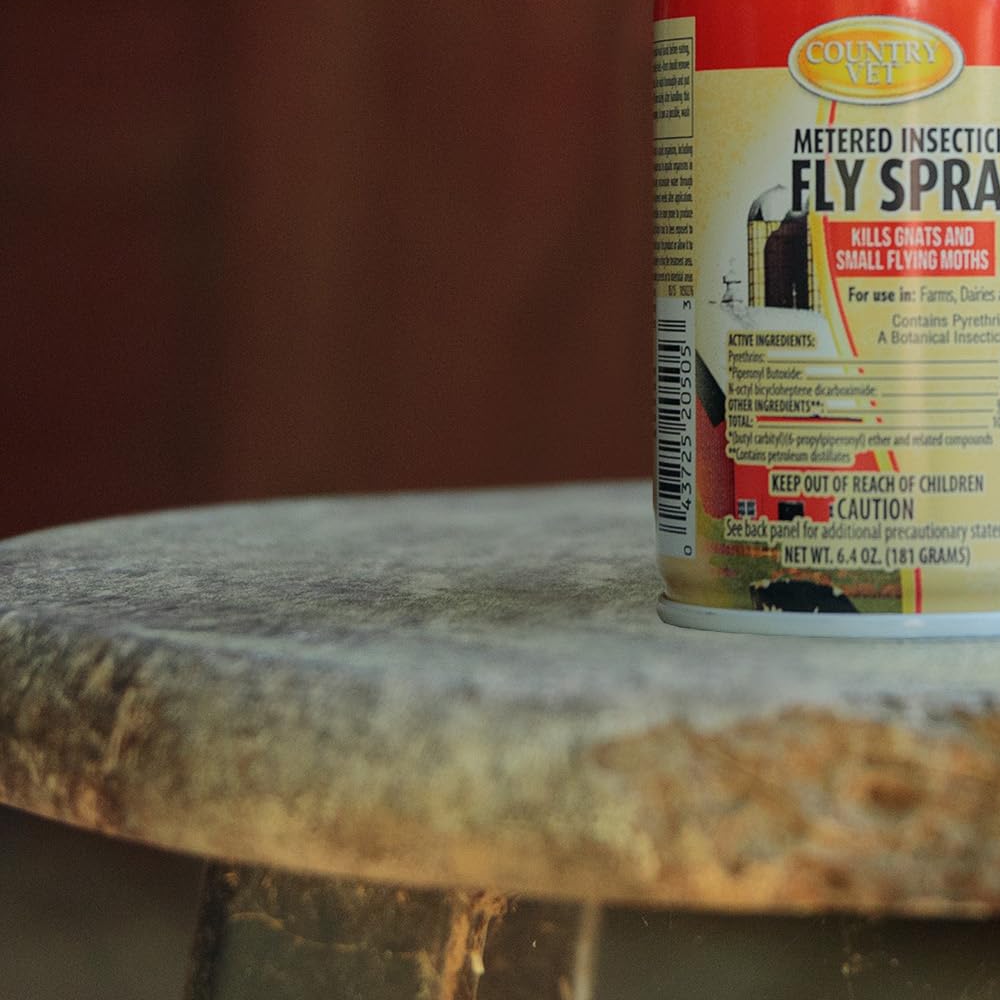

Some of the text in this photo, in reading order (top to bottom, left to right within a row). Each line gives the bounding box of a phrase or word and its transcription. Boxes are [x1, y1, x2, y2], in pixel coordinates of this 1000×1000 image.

[806, 39, 939, 64] COUNTRY
[846, 60, 900, 86] VET
[794, 128, 892, 153] METERED
[792, 159, 865, 212] FLY
[851, 226, 974, 247] KILLS GNATS AND
[836, 249, 990, 270] SMALL FLYING MOTHS
[848, 286, 869, 302] For
[873, 290, 895, 302] use
[900, 287, 916, 302] in:
[920, 286, 956, 304] Farms,
[960, 286, 996, 301] Dairies
[892, 314, 948, 328] Contains
[728, 334, 816, 347] ACTIVE INGREDIENTS:
[877, 331, 888, 344] A
[891, 330, 950, 344] Botanical
[728, 400, 752, 412] OTHER
[681, 300, 692, 556] 0 43725 20505 3
[728, 416, 753, 428] TOTAL:
[868, 433, 891, 446] ether
[894, 434, 910, 446] and
[912, 434, 943, 446] related
[945, 434, 992, 447] compounds
[768, 450, 809, 464] petroleum
[772, 474, 984, 492] KEEP OUT OF REACH OF CHILDREN
[838, 499, 914, 520] CAUTION
[726, 519, 742, 536] See
[745, 520, 766, 537] back
[771, 521, 800, 541] panel
[803, 521, 818, 538] for
[822, 522, 881, 539] additional
[885, 522, 968, 542] precautionary
[785, 546, 970, 566] NET WT. 6.4 OZ. (181 GRAMS)
